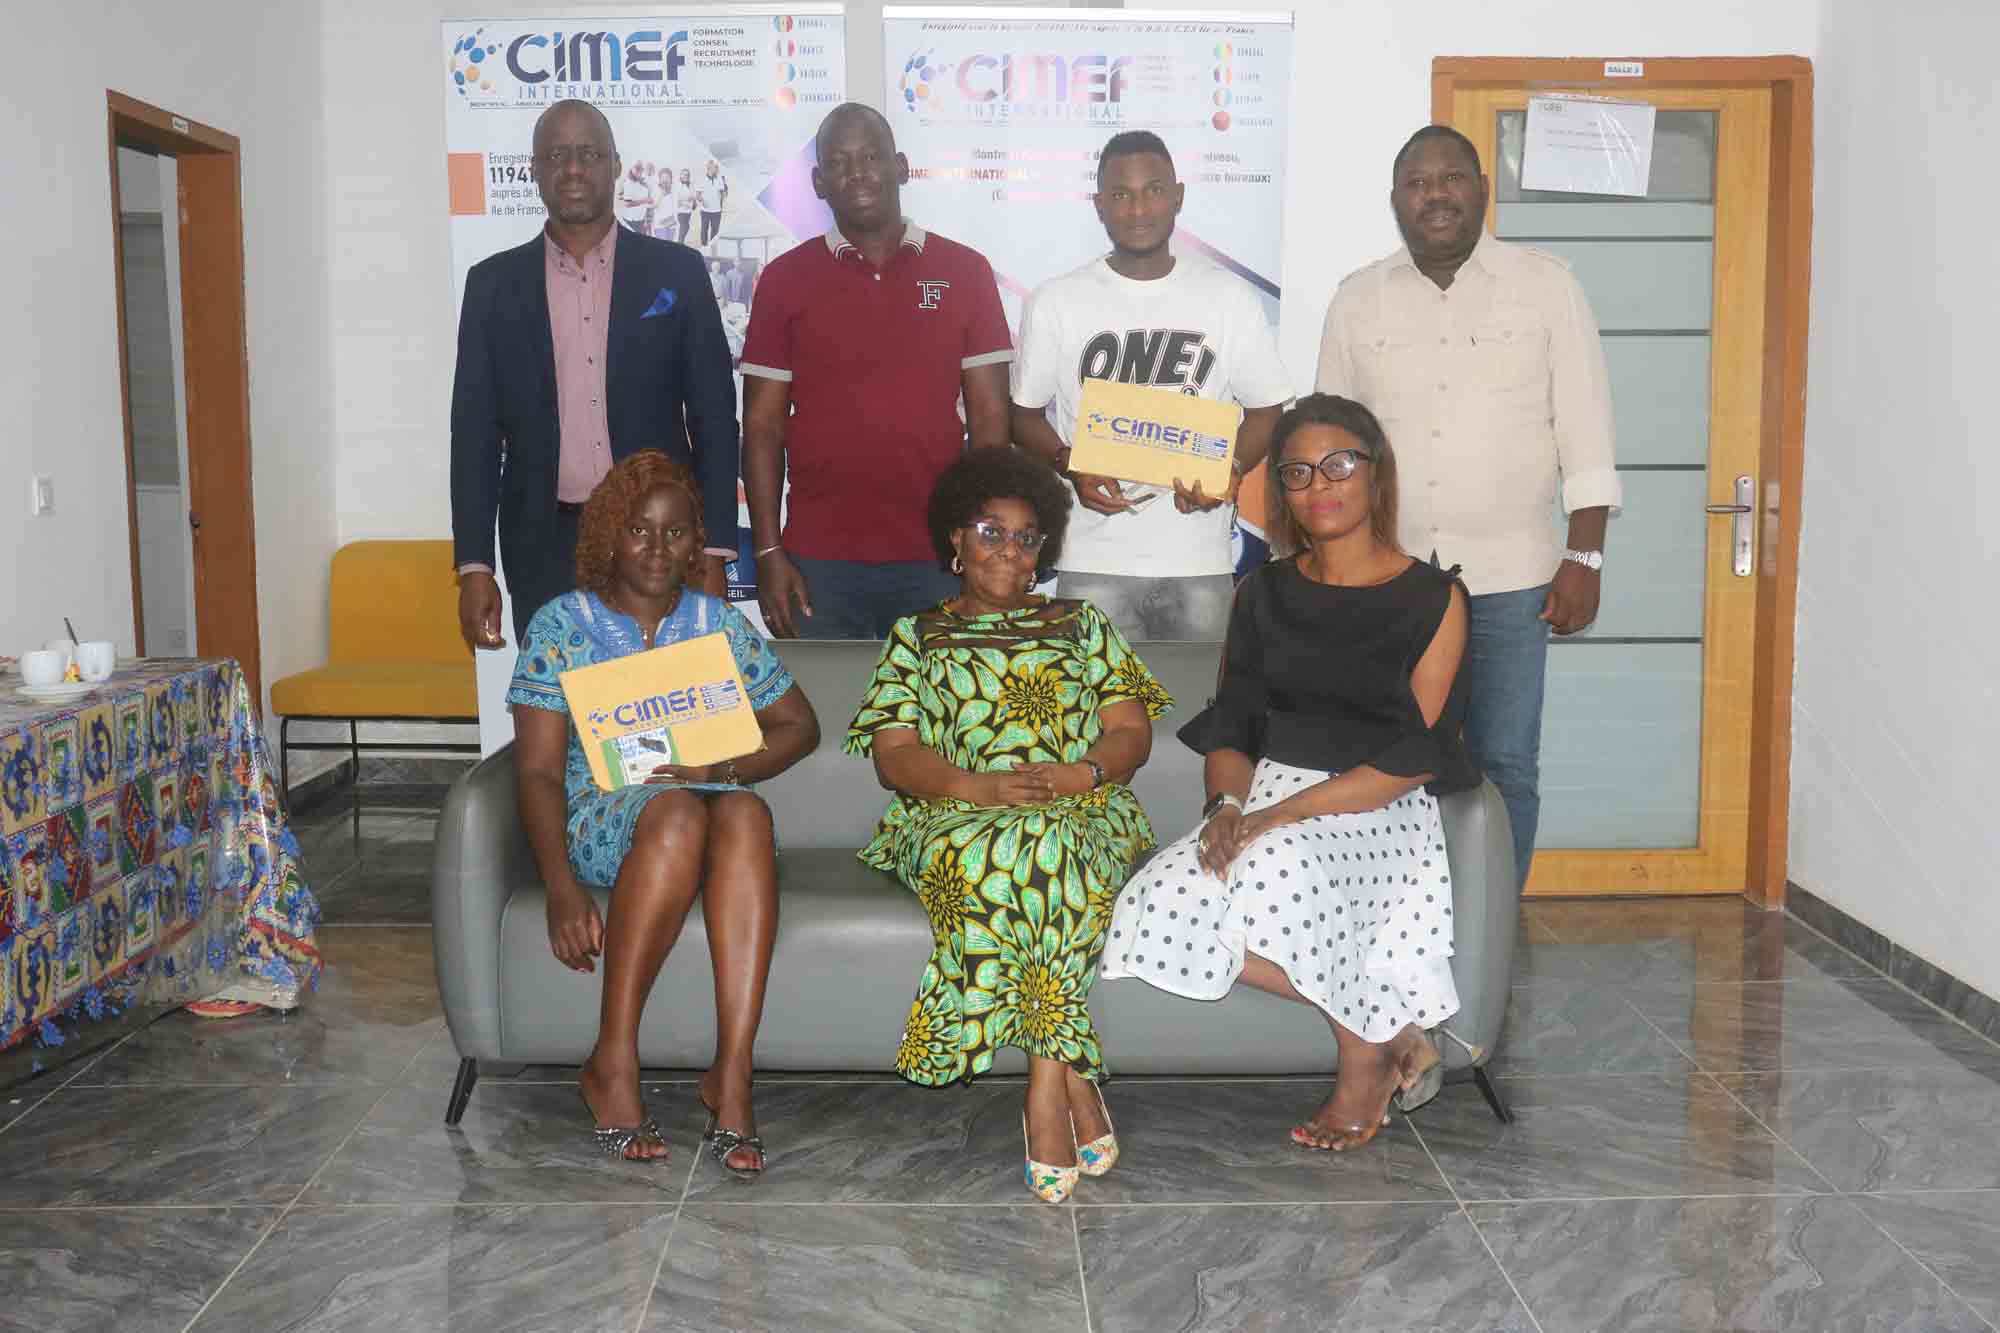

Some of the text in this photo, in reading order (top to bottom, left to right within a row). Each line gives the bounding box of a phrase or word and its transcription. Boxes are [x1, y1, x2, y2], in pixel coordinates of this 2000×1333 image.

[692, 28, 745, 36] FORMATION
[693, 39, 729, 47] CONSEIL
[506, 31, 689, 84] CIMEF
[693, 49, 757, 58] RECRUTEMENT
[518, 83, 684, 99] INTERNATIONAL
[917, 281, 950, 309] F
